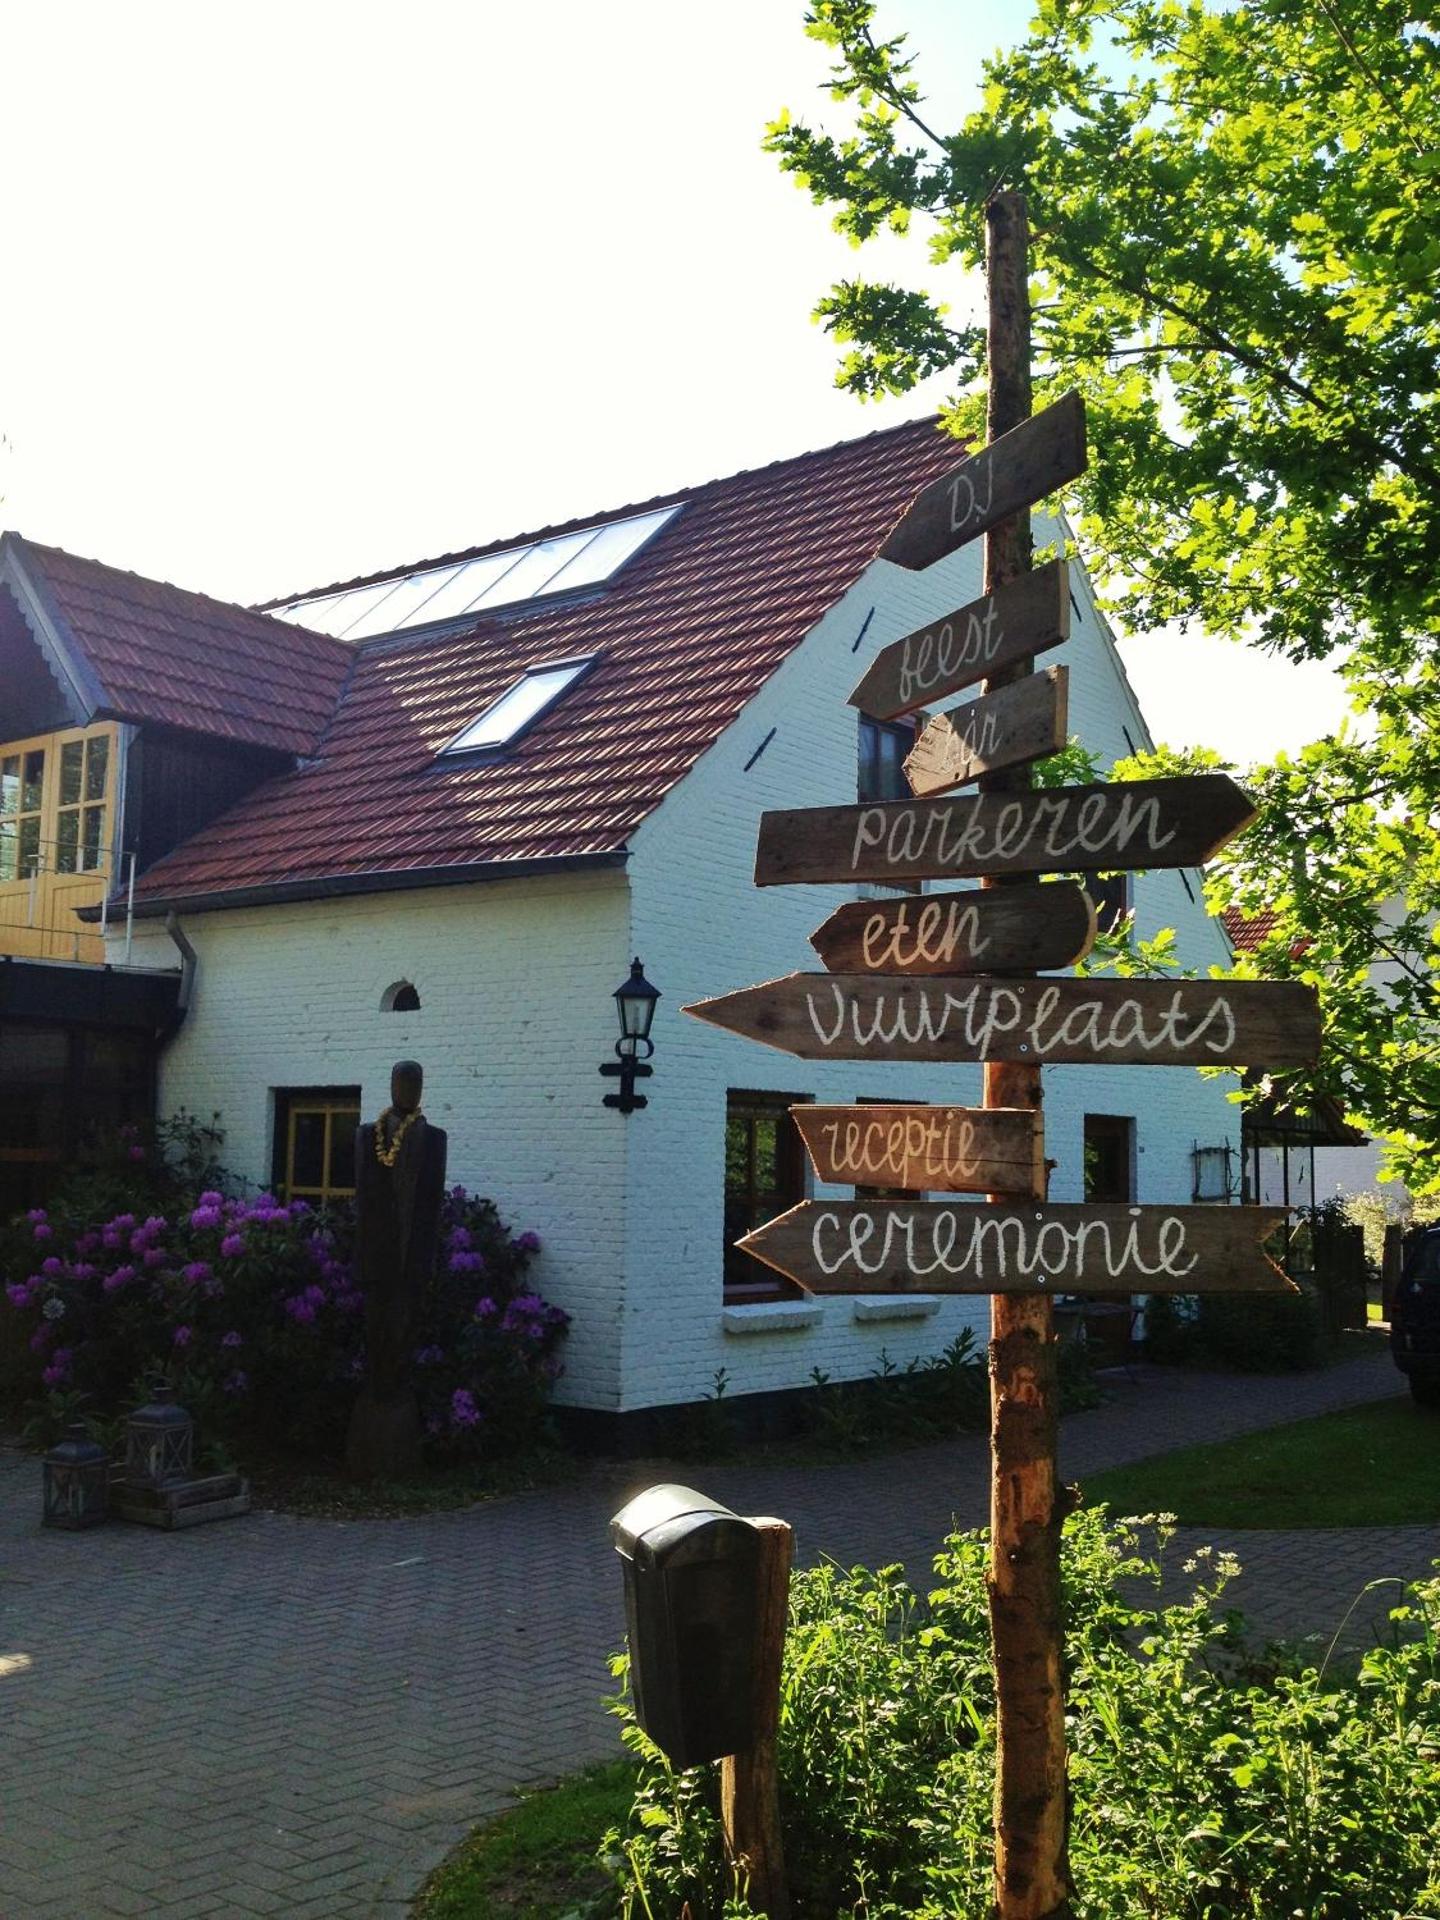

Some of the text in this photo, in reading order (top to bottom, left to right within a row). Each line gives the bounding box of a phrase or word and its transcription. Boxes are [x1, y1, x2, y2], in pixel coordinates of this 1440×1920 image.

[863, 902, 990, 968] eten
[822, 1112, 982, 1188] receptie
[811, 1208, 1200, 1279] ceremonie
